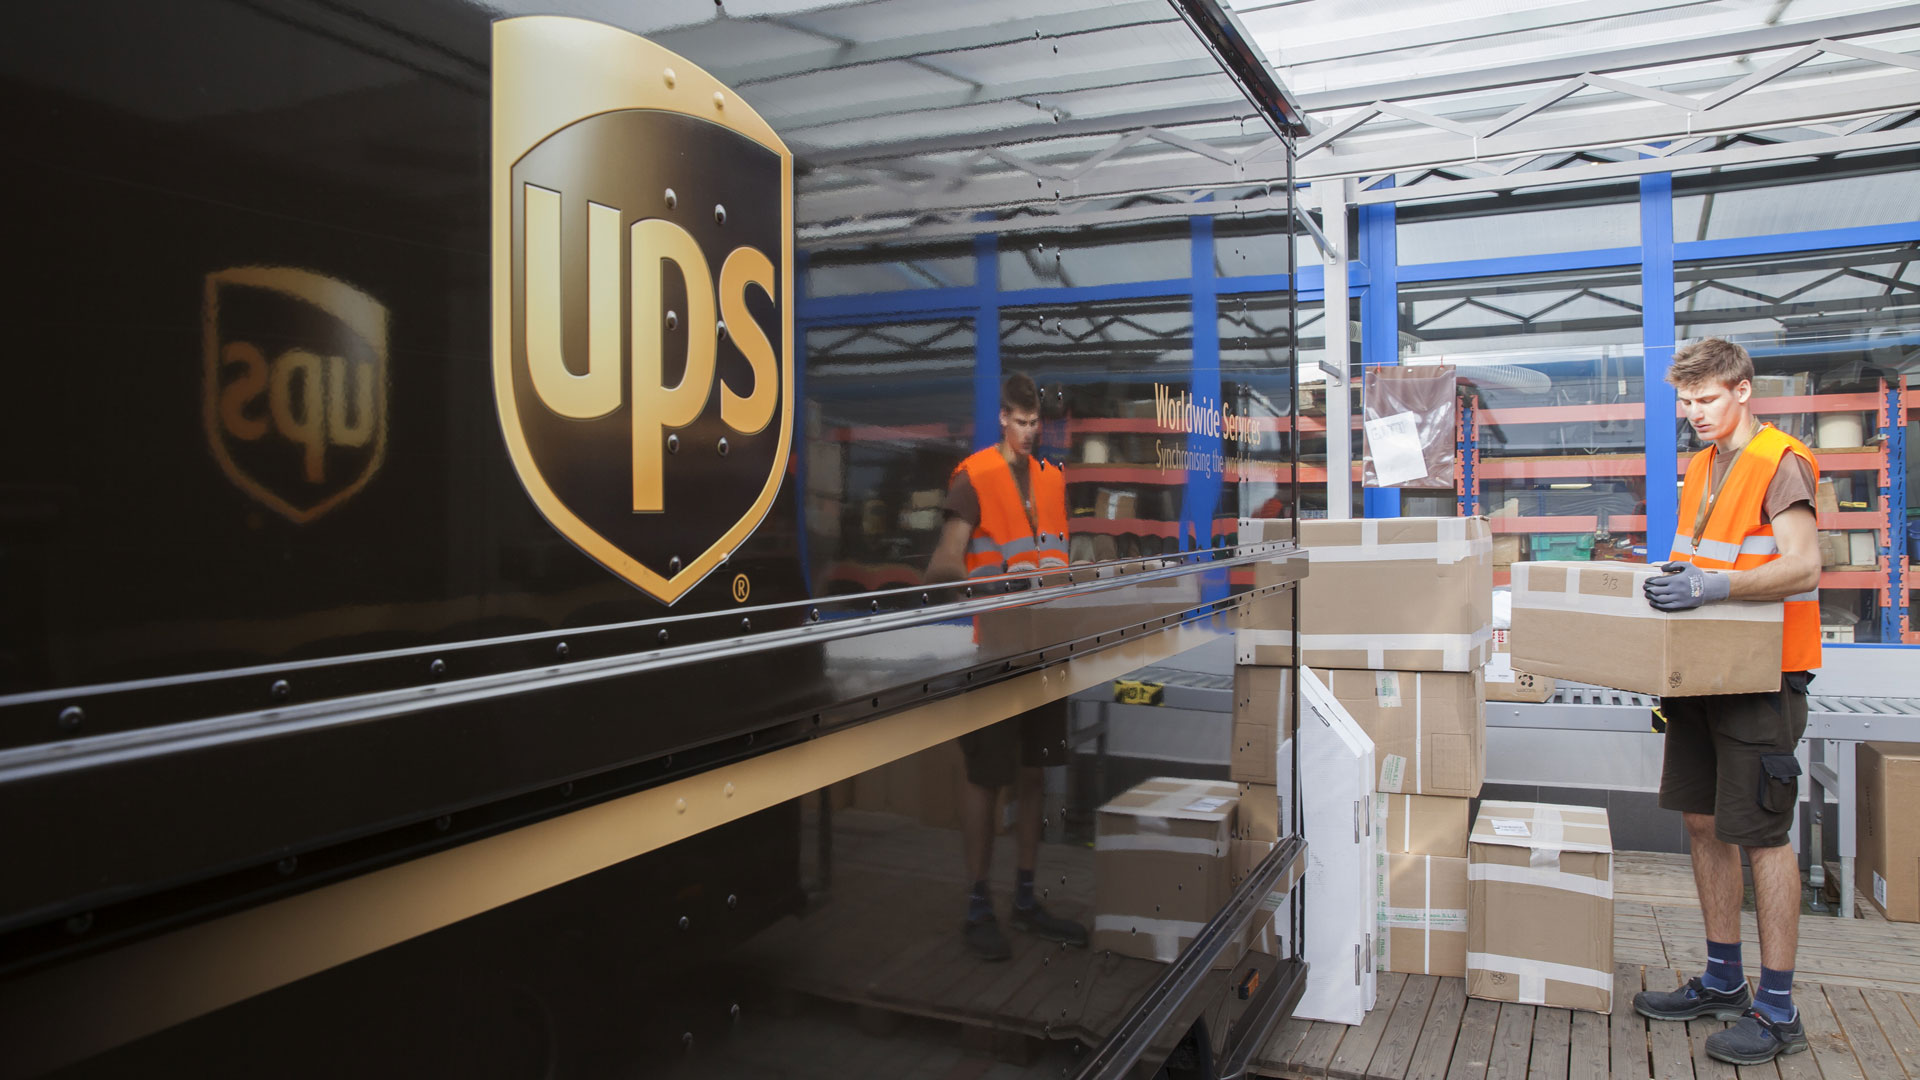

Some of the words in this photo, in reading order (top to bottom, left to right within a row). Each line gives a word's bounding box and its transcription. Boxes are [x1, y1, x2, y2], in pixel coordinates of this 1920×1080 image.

[524, 181, 778, 513] ups
[1154, 382, 1220, 438] Worldwide
[1222, 402, 1261, 446] Services
[1155, 439, 1211, 479] Synchronising
[1212, 448, 1224, 473] the
